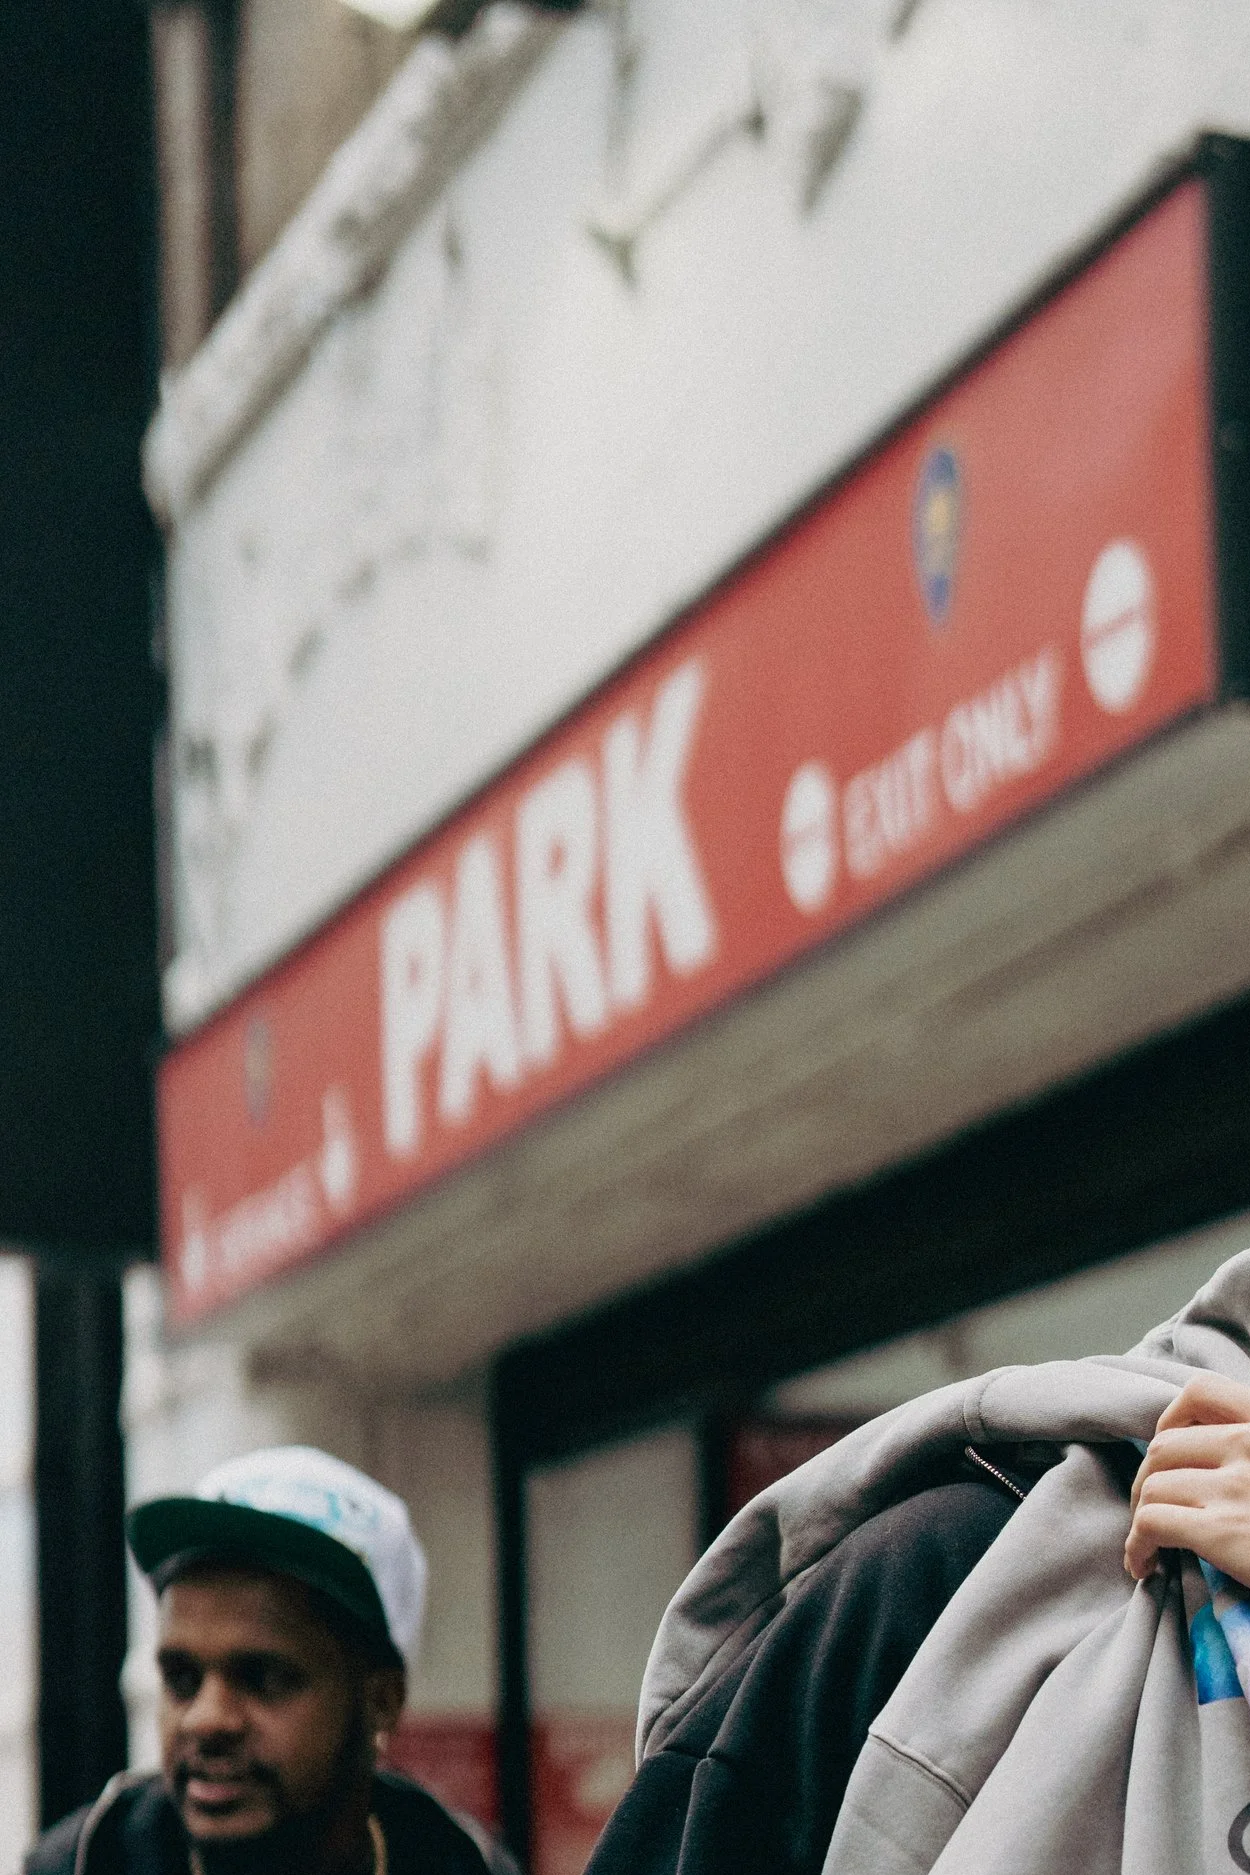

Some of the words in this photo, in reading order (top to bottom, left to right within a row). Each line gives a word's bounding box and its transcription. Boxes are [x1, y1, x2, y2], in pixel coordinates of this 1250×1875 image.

[379, 655, 716, 1161] PARK
[844, 726, 934, 878] EXIT
[941, 648, 1063, 812] ONLY
